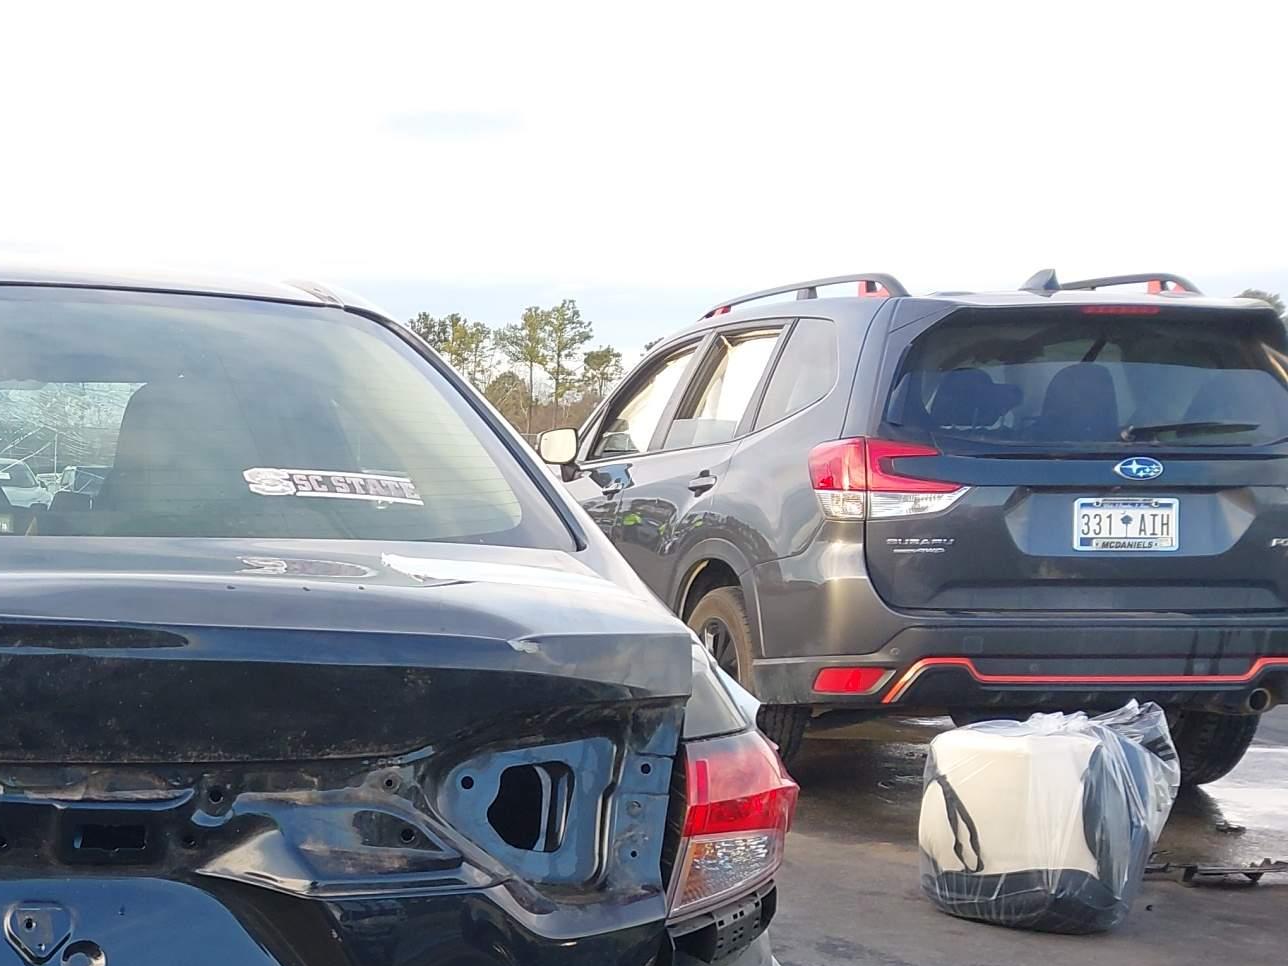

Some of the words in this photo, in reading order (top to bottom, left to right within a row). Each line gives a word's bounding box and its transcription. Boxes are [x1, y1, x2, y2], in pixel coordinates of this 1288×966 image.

[331, 476, 421, 500] STATE
[1081, 513, 1113, 536] 331
[1138, 513, 1171, 536] AIH
[1101, 540, 1153, 549] MCDANIELS
